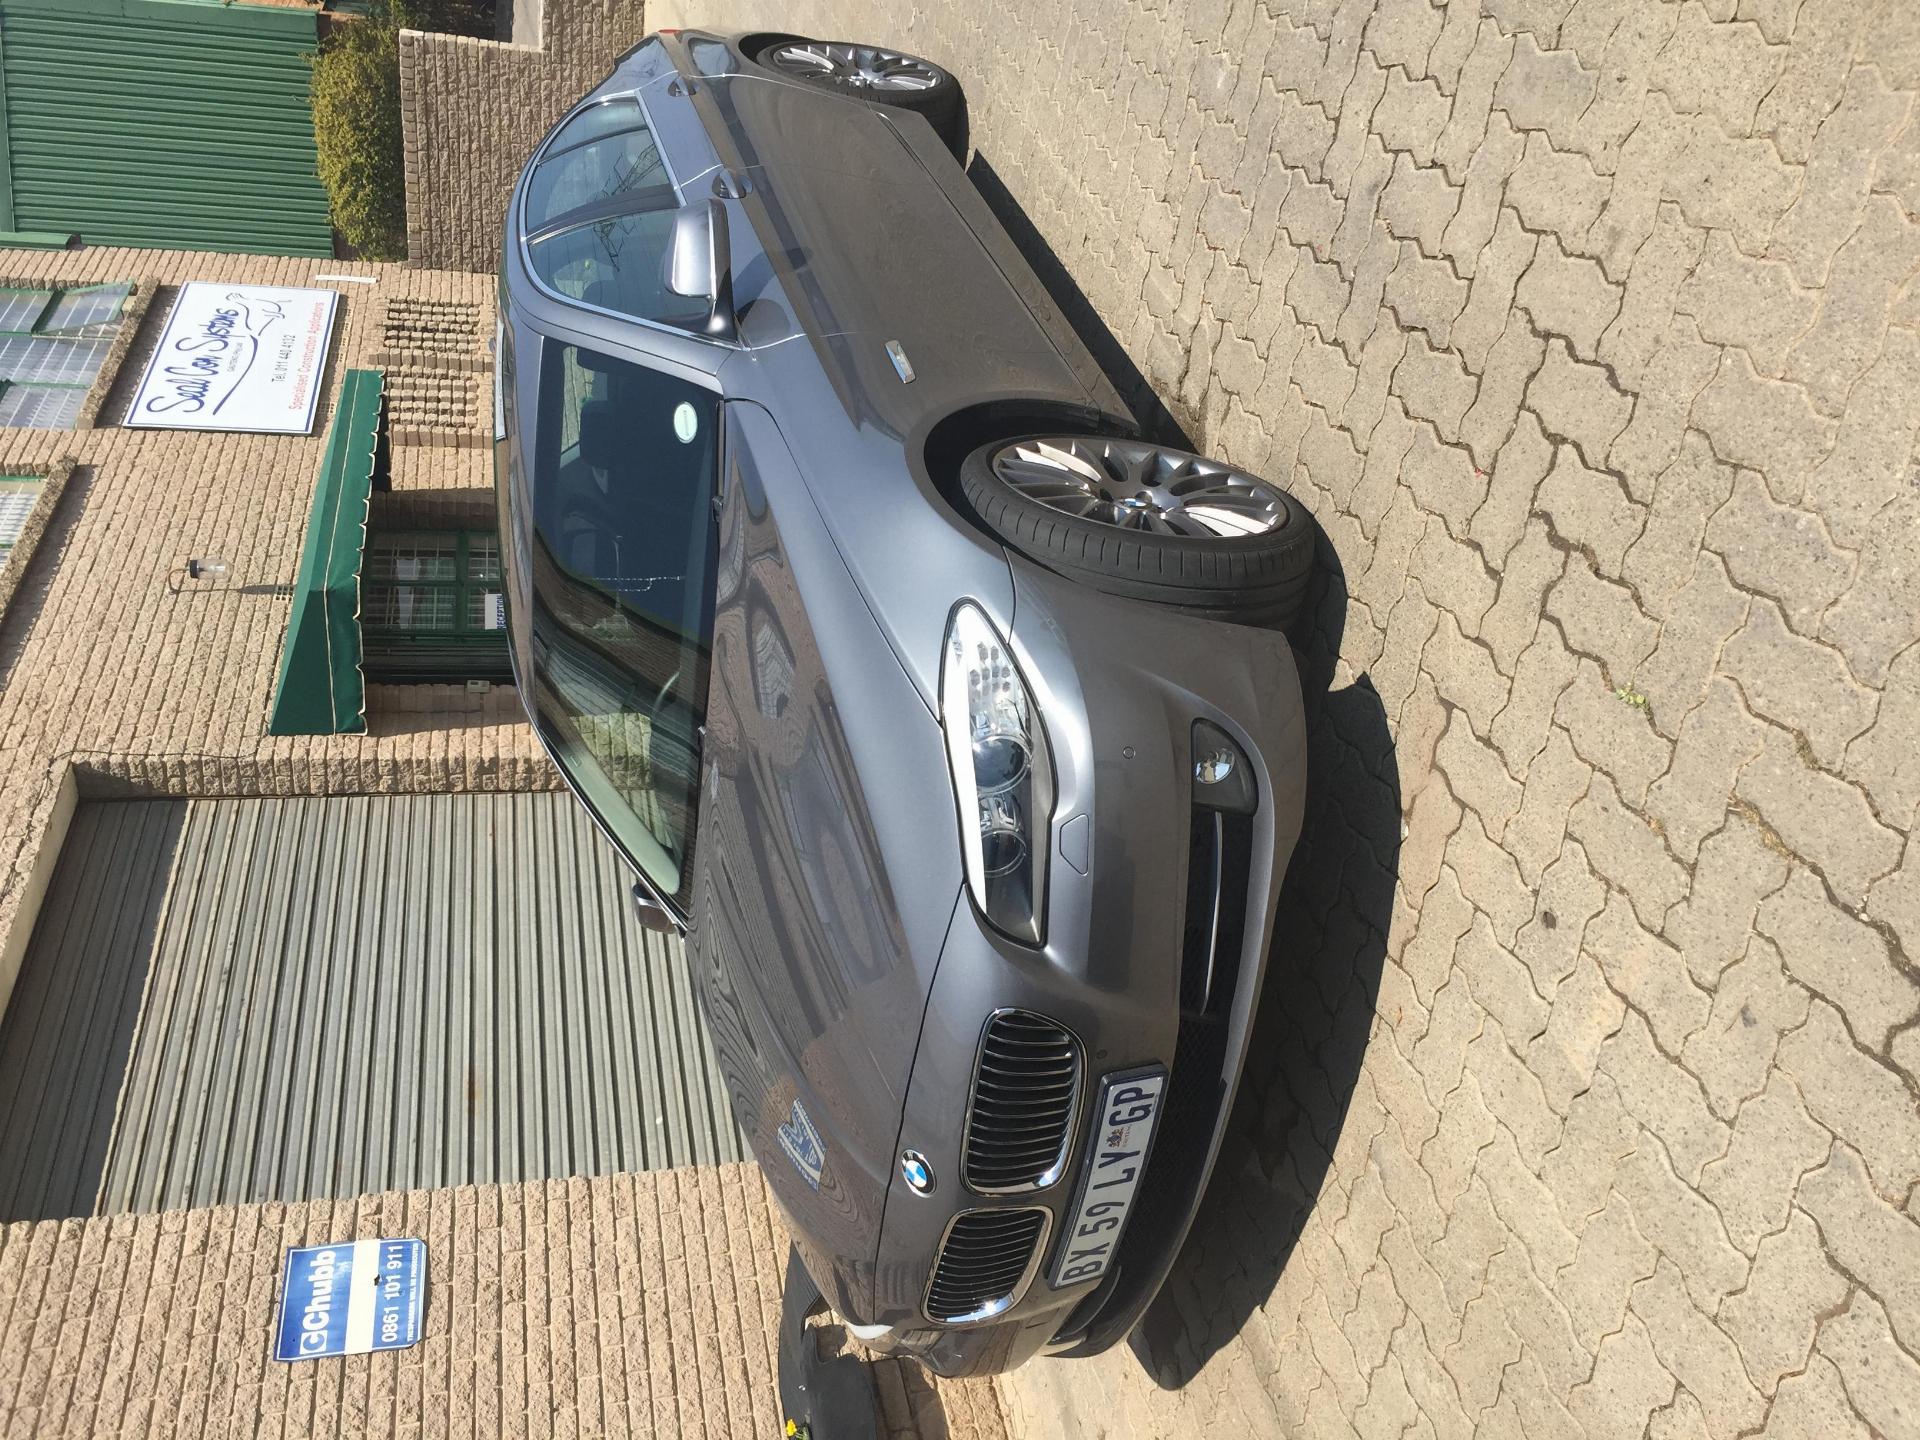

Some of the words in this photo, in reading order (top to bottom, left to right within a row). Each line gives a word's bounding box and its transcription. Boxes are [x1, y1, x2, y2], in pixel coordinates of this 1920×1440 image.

[175, 307, 246, 352] Systems
[305, 301, 325, 334] Applications
[279, 349, 292, 360] 440
[281, 334, 296, 348] 4132
[297, 335, 317, 373] Construction
[164, 354, 223, 377] Con
[274, 361, 288, 371] 011
[146, 378, 211, 413] Seal
[288, 374, 309, 410] Specialised
[1109, 1086, 1155, 1128] GP
[1093, 1150, 1141, 1190] LY
[1078, 1201, 1126, 1238] 59
[386, 1245, 403, 1270] 911
[1062, 1241, 1111, 1282] BX
[302, 1250, 337, 1331] Chubb
[384, 1274, 401, 1301] 101
[381, 1306, 399, 1342] 0861
